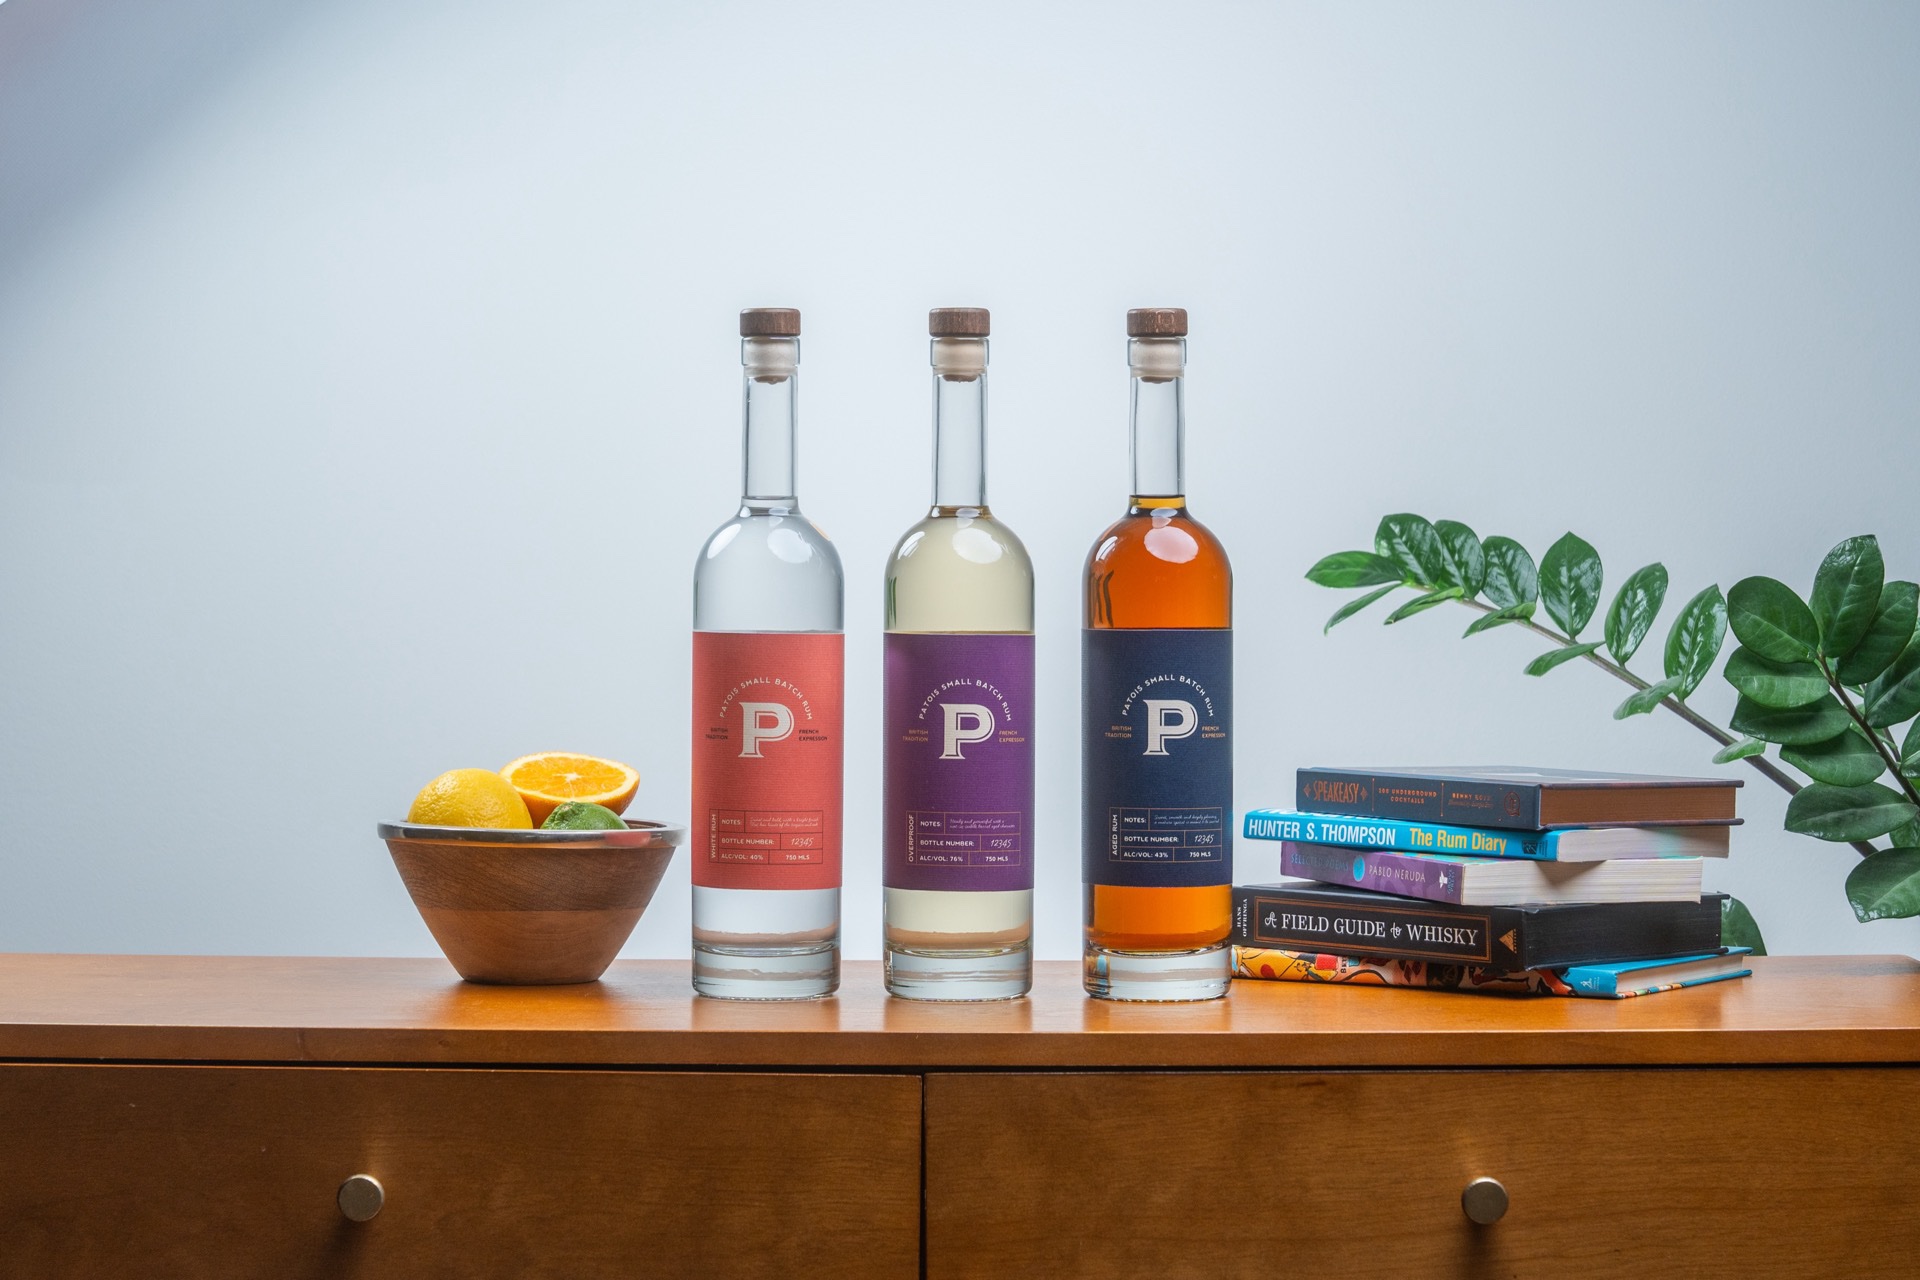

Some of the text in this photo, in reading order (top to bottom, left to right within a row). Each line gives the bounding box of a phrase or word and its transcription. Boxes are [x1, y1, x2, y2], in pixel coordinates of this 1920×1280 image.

[720, 676, 813, 721] PATOIS SMALL BATCH RUM
[919, 678, 1012, 722] PATOIS SMALL BATCH RUM
[1122, 674, 1214, 717] PATOIS SMALL BATCH RUM
[738, 702, 795, 758] P
[939, 703, 995, 760] P
[1142, 699, 1198, 756] P
[1313, 780, 1359, 804] SPEAKEASY
[1390, 796, 1425, 804] COCKTAILS
[1392, 789, 1437, 798] UNDERGROUND
[791, 837, 814, 847] 12345
[990, 839, 1012, 848] 12345
[1194, 835, 1214, 844] 12345
[1248, 819, 1507, 855] HUNTER S. THOMPSON The Rum Diary
[1291, 853, 1349, 871] SELECTED POEMS
[1369, 865, 1426, 883] PABLO NERUDA
[1264, 912, 1478, 946] A FIELD GUIDE to WHISKY
